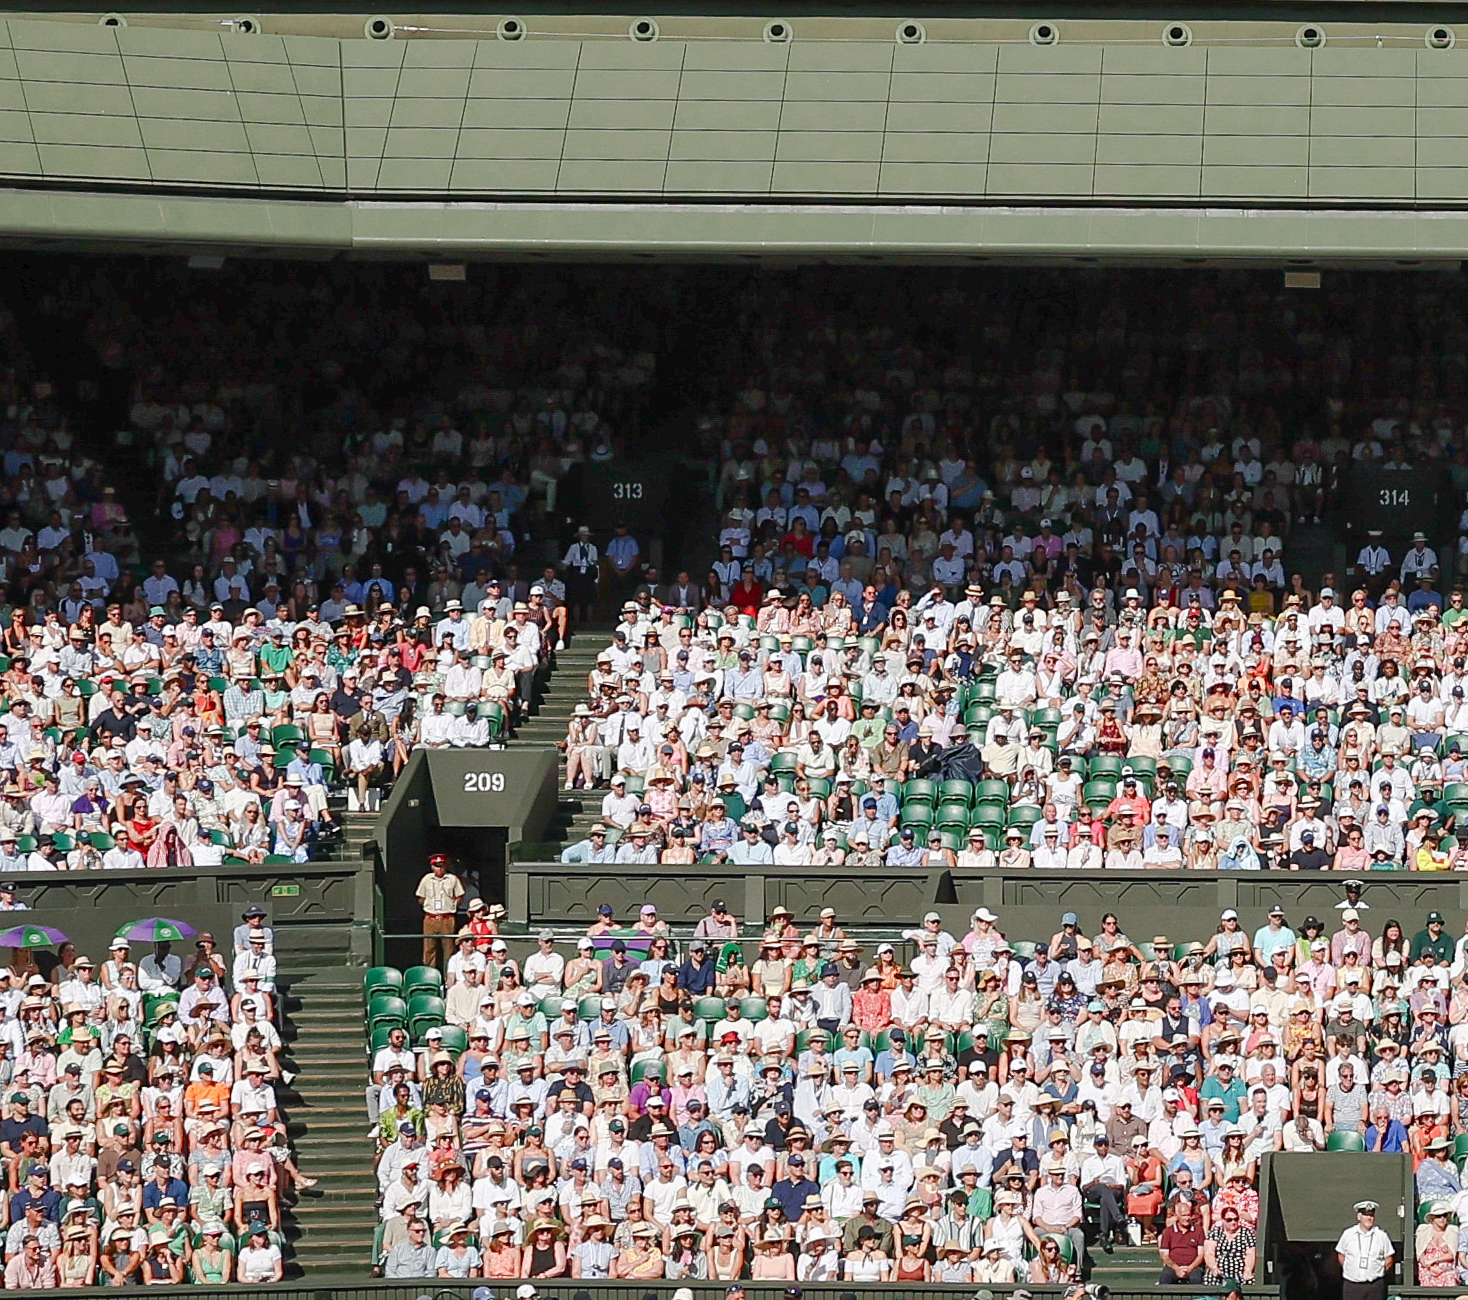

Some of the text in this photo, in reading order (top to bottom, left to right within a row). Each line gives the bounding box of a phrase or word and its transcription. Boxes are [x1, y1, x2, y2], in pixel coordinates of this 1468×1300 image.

[614, 483, 643, 499] 313
[1380, 489, 1410, 506] 314
[464, 772, 505, 792] 209
